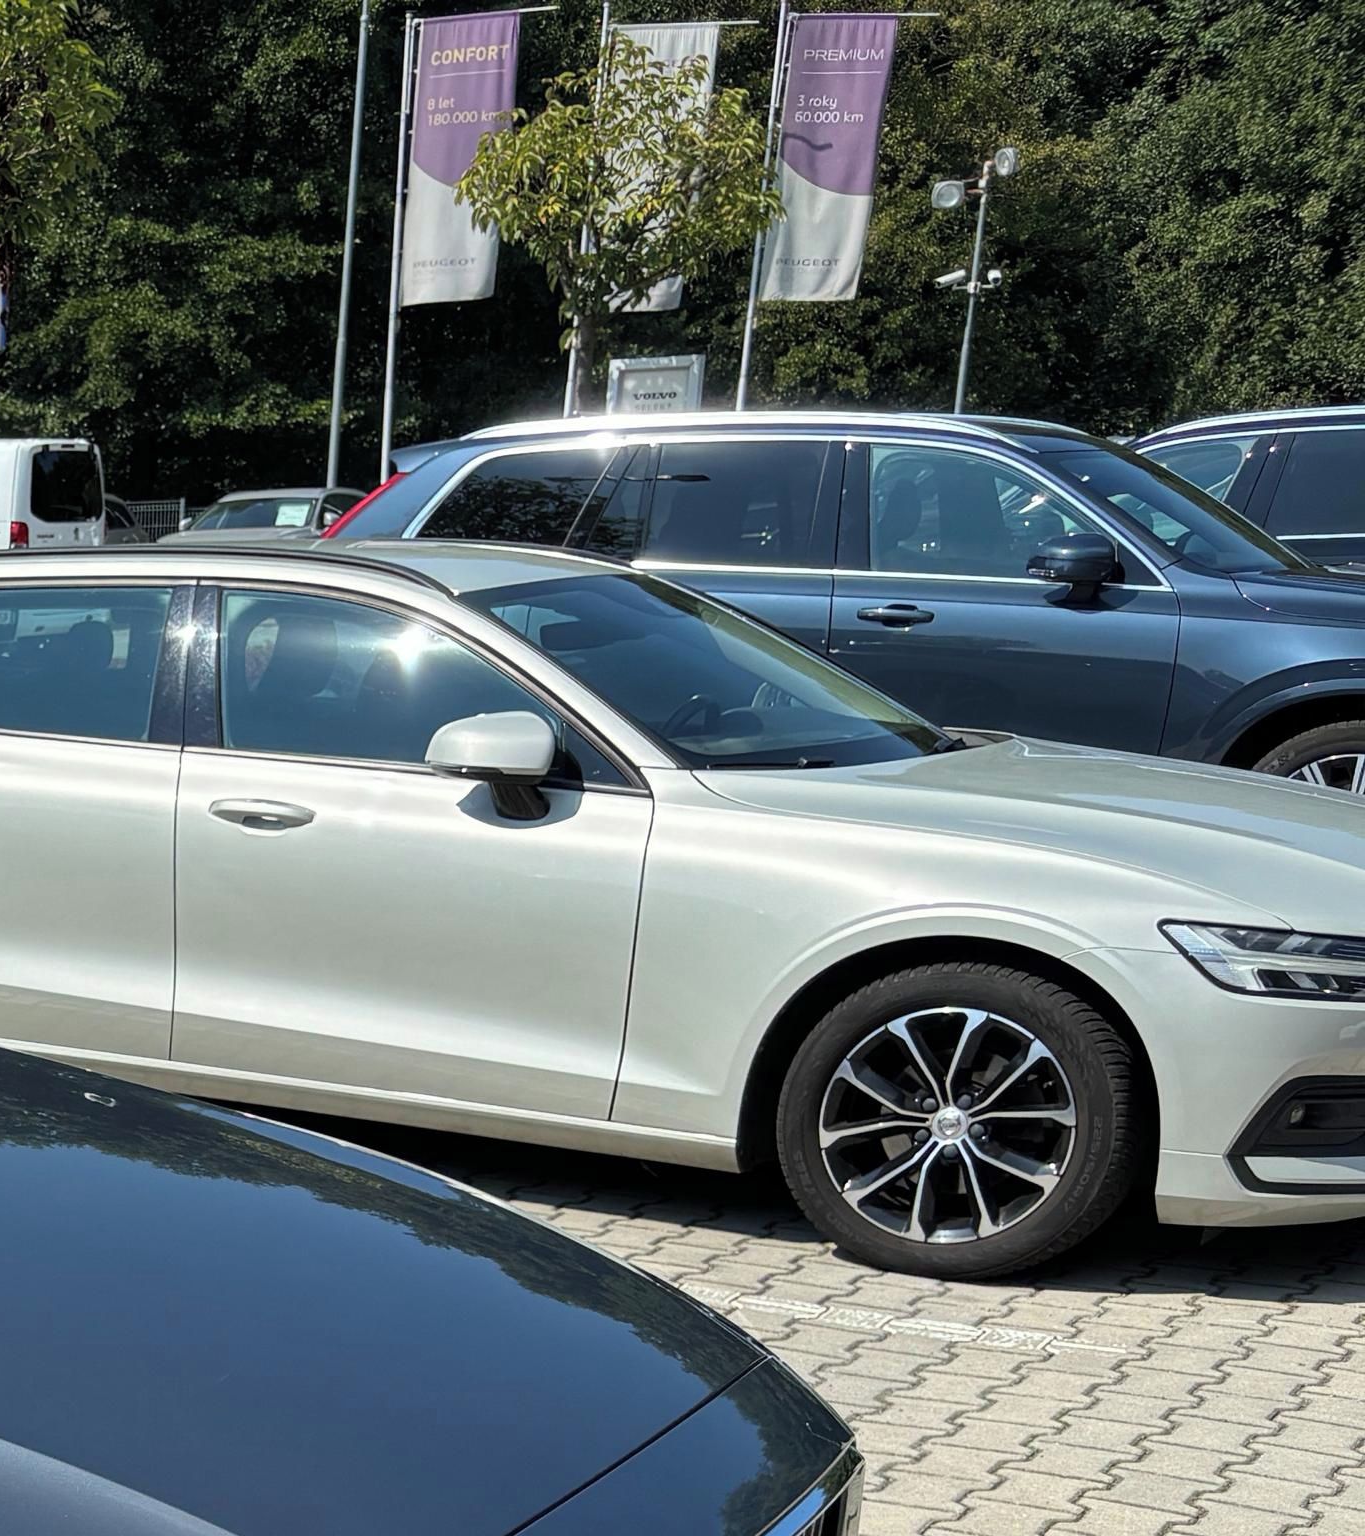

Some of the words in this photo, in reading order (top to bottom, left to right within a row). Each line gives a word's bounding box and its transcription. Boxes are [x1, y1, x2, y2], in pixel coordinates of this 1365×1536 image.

[431, 44, 510, 66] CONFORT
[804, 48, 885, 61] PREMIUM
[438, 97, 454, 109] let
[797, 95, 805, 107] 3
[809, 95, 837, 110] roky
[429, 110, 478, 127] 180.000
[795, 111, 840, 123] 60.000
[843, 111, 864, 122] km
[633, 391, 677, 401] VOLVO
